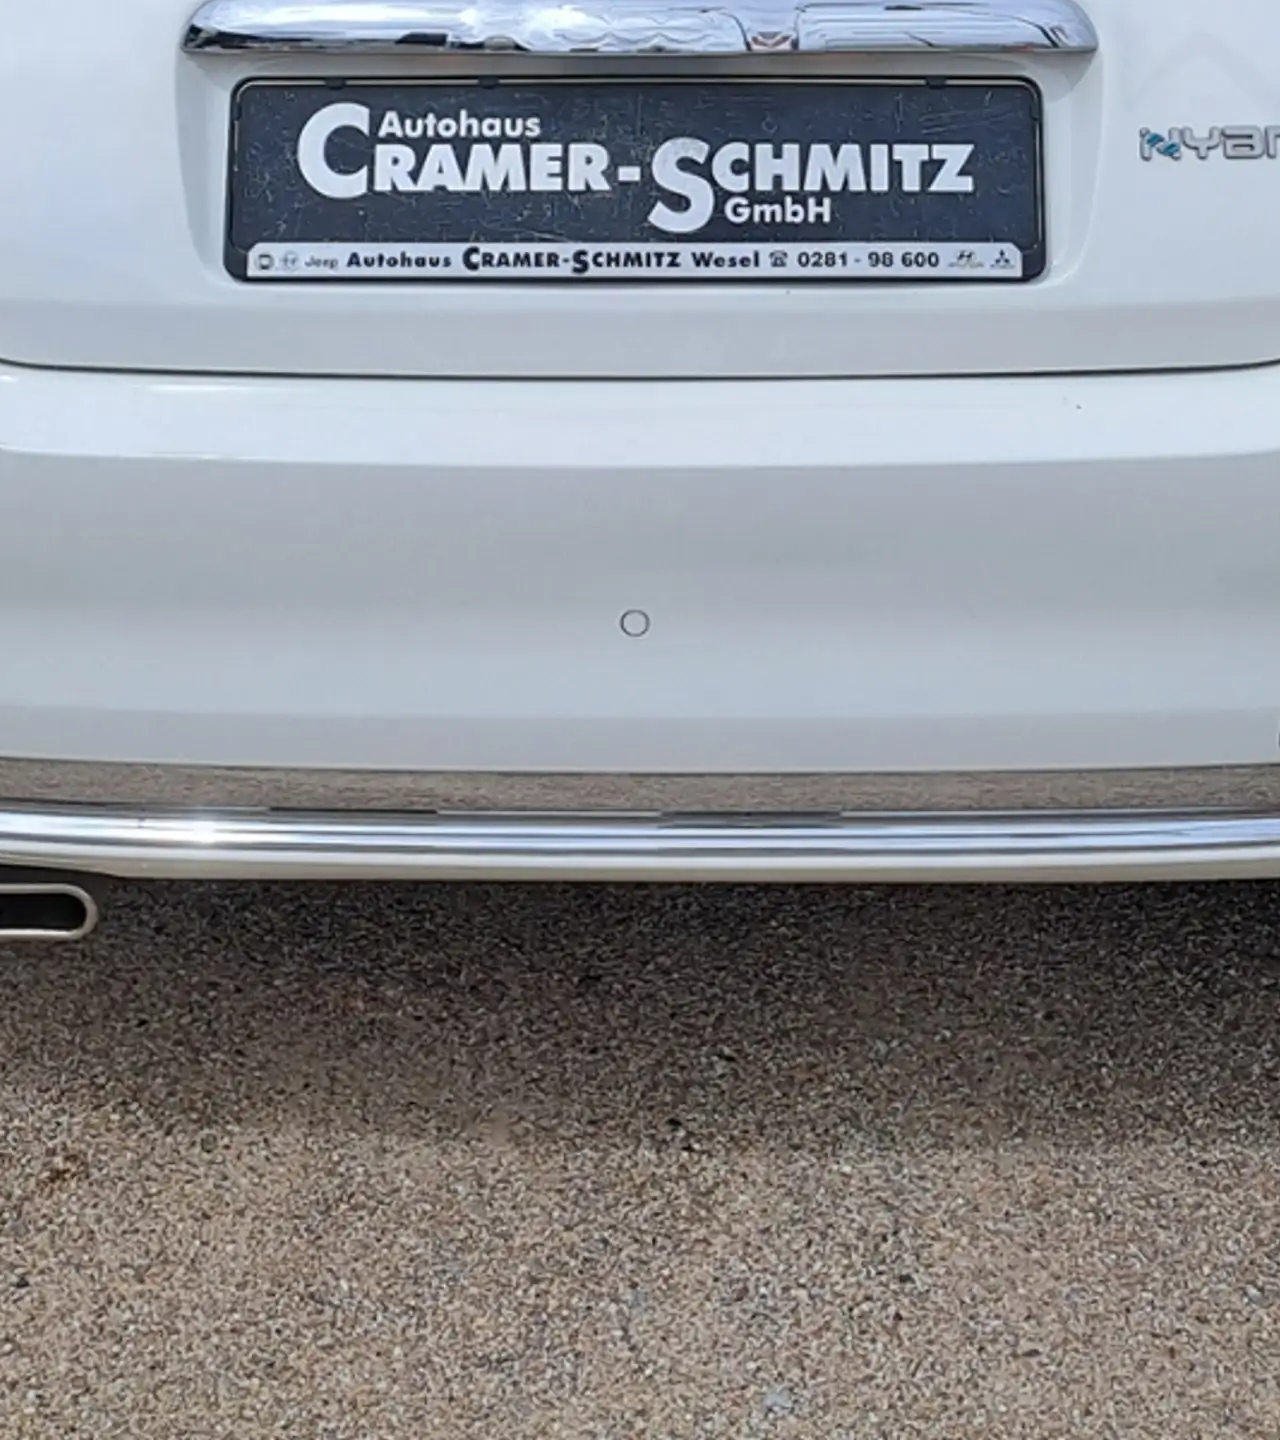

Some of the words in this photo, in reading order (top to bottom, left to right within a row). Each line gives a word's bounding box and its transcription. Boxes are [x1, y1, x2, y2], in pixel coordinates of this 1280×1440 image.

[378, 110, 541, 139] Autohaus
[297, 102, 975, 233] CRAMER-SCHMITZ
[725, 197, 832, 224] GmbH
[346, 251, 452, 269] Autohaus
[462, 246, 681, 273] CRAMER-SCHMITZ
[691, 250, 760, 269] Wesel
[797, 250, 848, 268] 0281
[868, 250, 894, 268] 98
[902, 250, 939, 268] 600
